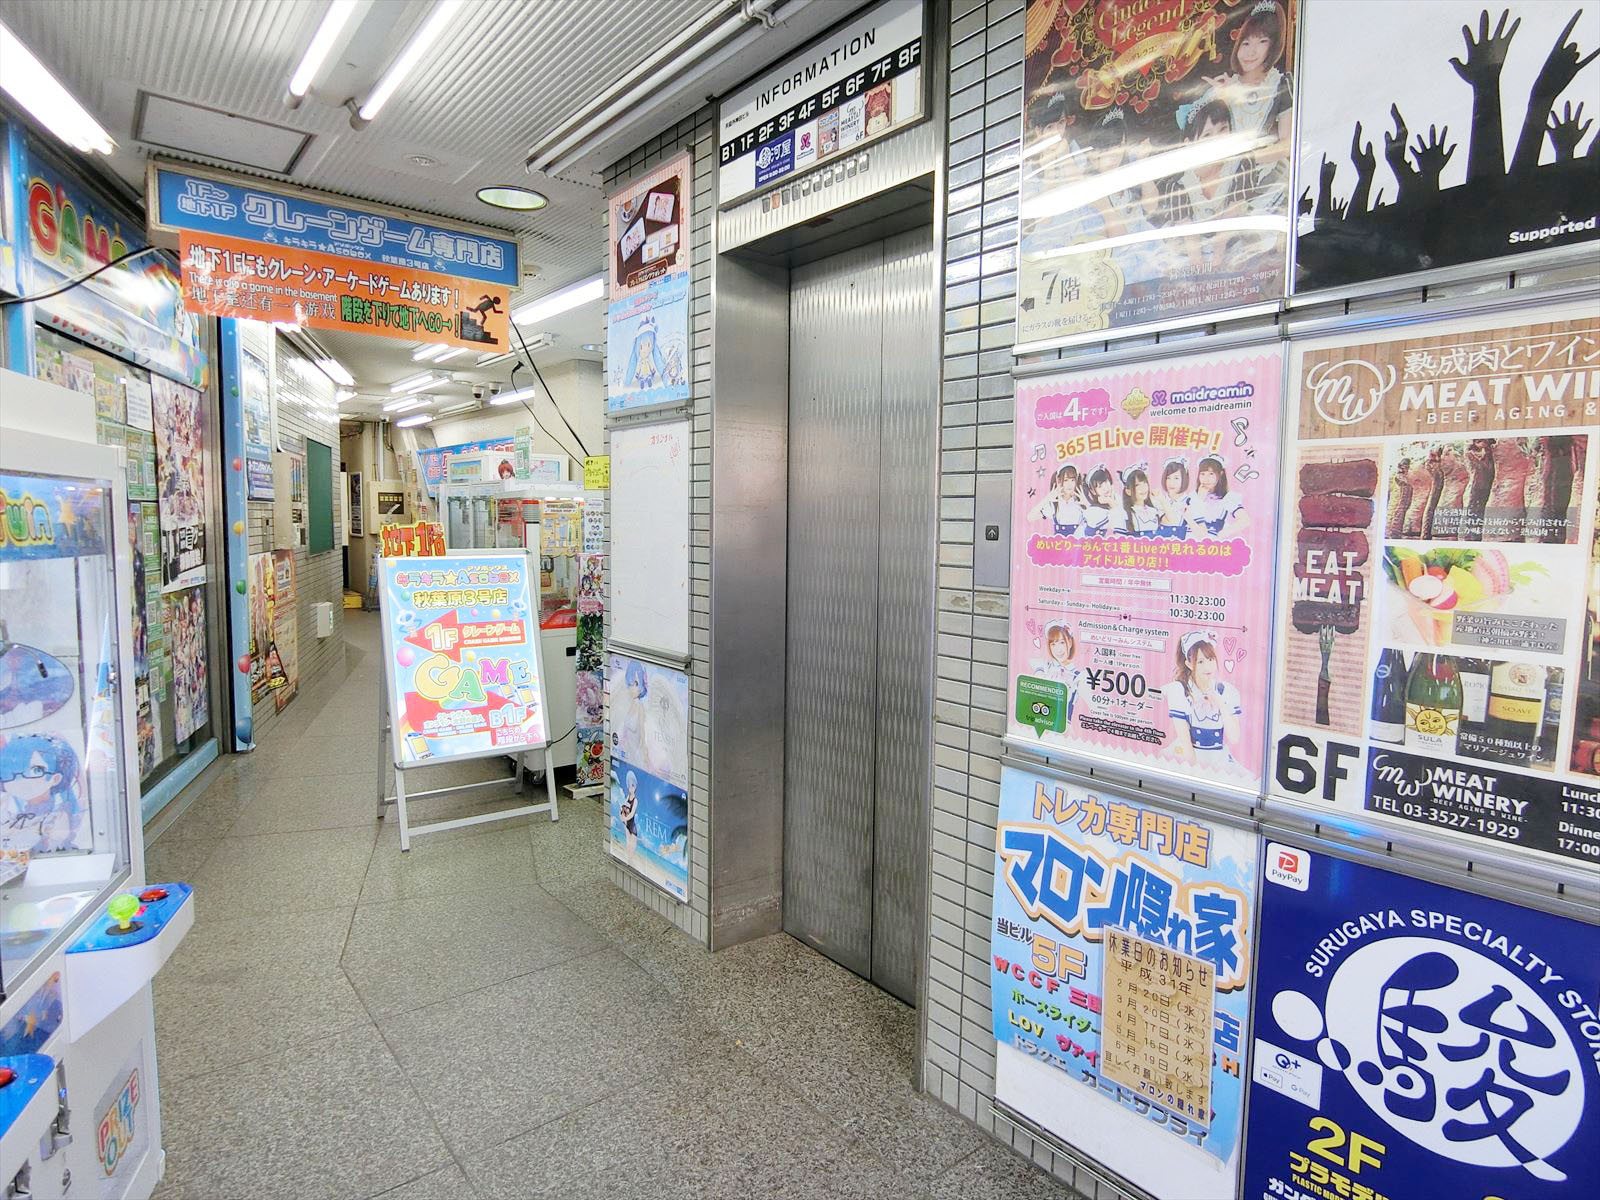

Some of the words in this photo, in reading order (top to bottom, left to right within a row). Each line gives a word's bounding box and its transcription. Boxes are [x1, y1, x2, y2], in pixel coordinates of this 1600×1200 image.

[755, 28, 876, 111] INFORMATION
[722, 142, 735, 162] B1
[740, 133, 754, 152] 1F
[758, 122, 774, 142] 2F
[778, 110, 795, 132] 3F
[798, 99, 816, 120] 4F
[822, 86, 840, 108] 5F
[846, 72, 865, 96] 6F
[872, 57, 892, 83] 7F
[898, 42, 920, 68] 8F
[178, 195, 237, 220] 地下1F
[243, 193, 503, 270] クレーンゲーム専門店
[1508, 217, 1597, 244] Supported
[249, 282, 274, 294] game
[275, 284, 284, 295] in
[284, 286, 298, 297] the
[299, 288, 338, 303] basement
[1041, 266, 1081, 304] 7階
[1170, 382, 1254, 404] maidreamin
[1400, 378, 1511, 410] MEAT
[1150, 404, 1186, 418] welcome
[1188, 406, 1198, 414] to
[1198, 400, 1252, 412] maidreamin
[1494, 404, 1566, 420] AGING
[1584, 402, 1597, 416] &
[1056, 428, 1144, 460] 365日Live
[1306, 550, 1359, 576] EAT
[413, 588, 508, 608] 秋葉原3号店
[1066, 600, 1086, 608] Sunday
[1092, 604, 1113, 612] Holiday
[1170, 594, 1226, 608] 11:30-23:00
[1169, 608, 1226, 622] 10:30-23:00
[424, 622, 458, 650] 1F
[462, 622, 521, 638] クレーンゲーム
[1094, 647, 1116, 658] 入国料
[415, 655, 531, 702] GAME
[1020, 681, 1064, 696] RECOMMENDED
[489, 704, 527, 728] B1F
[1416, 734, 1442, 744] SULA
[1276, 733, 1360, 801] 6F
[1432, 766, 1496, 792] MEAT
[1430, 784, 1529, 816] WINERY
[645, 817, 668, 844] REM
[1032, 781, 1211, 869] トレカ専門店
[1373, 794, 1400, 813] TEL
[1402, 804, 1520, 840] 03-3527-1929
[1272, 868, 1303, 886] PayPay
[1003, 829, 1239, 977] マロン隠れ家
[996, 918, 1033, 943] 当ビル
[1032, 933, 1087, 981] 5F
[1109, 932, 1208, 988] 休業日のお知らせ
[994, 954, 1061, 994] WCCF
[1120, 958, 1192, 996] 平成31年
[1305, 909, 1406, 978] SURUGAYA
[1409, 908, 1564, 986] SPECIALTY
[1557, 990, 1600, 1077] STO
[1008, 1010, 1044, 1038] LOV
[1306, 1116, 1386, 1174] 2F
[1292, 1174, 1322, 1196] PLASTIC
